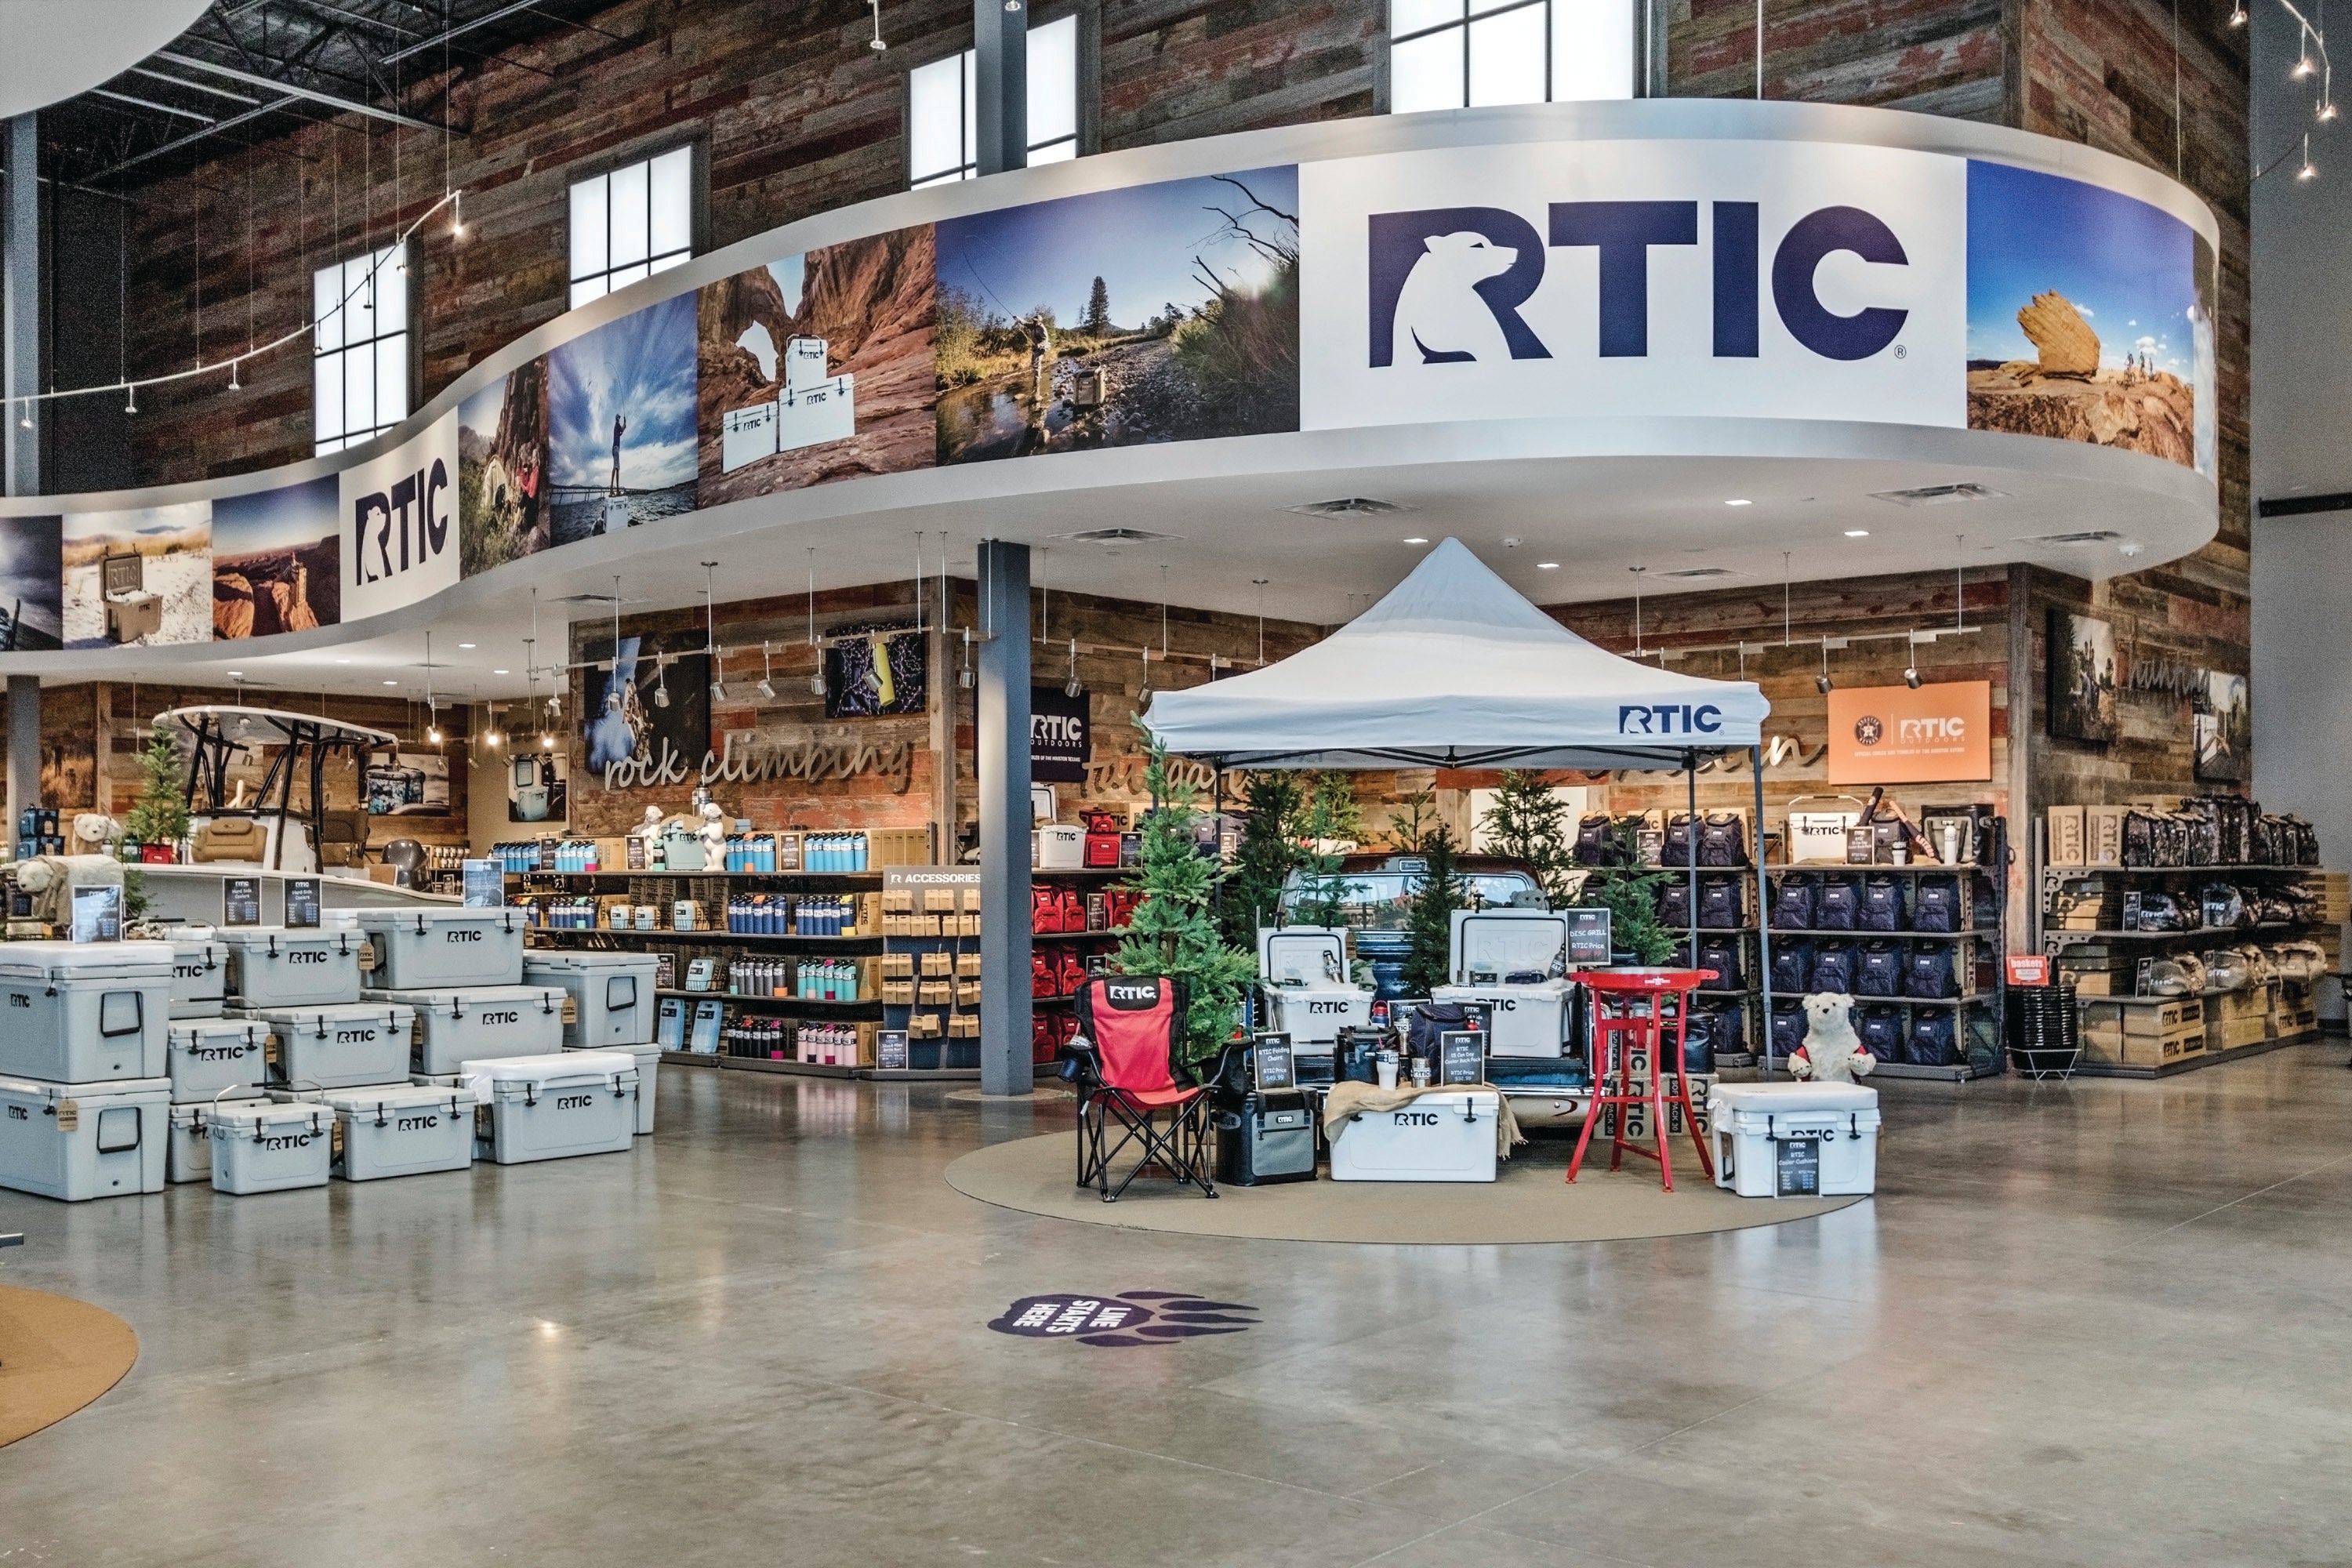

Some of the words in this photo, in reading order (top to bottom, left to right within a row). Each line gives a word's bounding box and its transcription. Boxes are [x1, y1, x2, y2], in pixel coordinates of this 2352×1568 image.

[1368, 201, 1910, 368] RTIC
[806, 393, 826, 405] RTIC
[743, 419, 761, 431] RTIC
[355, 457, 448, 586] RTIC
[1618, 704, 1722, 734] RTIC
[1030, 714, 1082, 740] RTIC
[1900, 717, 1965, 739] RTIC
[1030, 739, 1082, 748] OUTDOORS
[1900, 736, 1965, 745] OUTDOORS
[604, 736, 688, 791] rock
[701, 726, 909, 794] climbing
[1112, 815, 1127, 826] TIC
[1057, 833, 1076, 841] RTIC
[1809, 826, 1840, 836] RTIC
[2065, 815, 2080, 862] RTIC
[905, 873, 980, 884] ACCESSORIES
[447, 930, 482, 942] RTIC
[289, 951, 328, 964] RTIC
[2010, 958, 2043, 968] baskets
[1109, 985, 1156, 1000] RTIC
[10, 993, 30, 1008] RTIC
[1309, 1002, 1348, 1014] RTIC
[1475, 998, 1516, 1011] TIC
[482, 1011, 519, 1025] RTIC
[337, 1029, 376, 1044] RTIC
[201, 1046, 244, 1061] RTIC
[2164, 1043, 2180, 1057] RTIC
[1631, 1049, 1646, 1071] IC
[557, 1094, 593, 1109] RTIC
[1692, 1078, 1708, 1134] RTIC
[9, 1105, 28, 1120] RTIC
[1394, 1113, 1439, 1126] RTIC
[398, 1116, 437, 1131] RTIC
[266, 1134, 310, 1151] RTIC
[1012, 1303, 1061, 1328] HERE
[1045, 1300, 1101, 1334] STARTS
[1089, 1306, 1132, 1328] LINE
